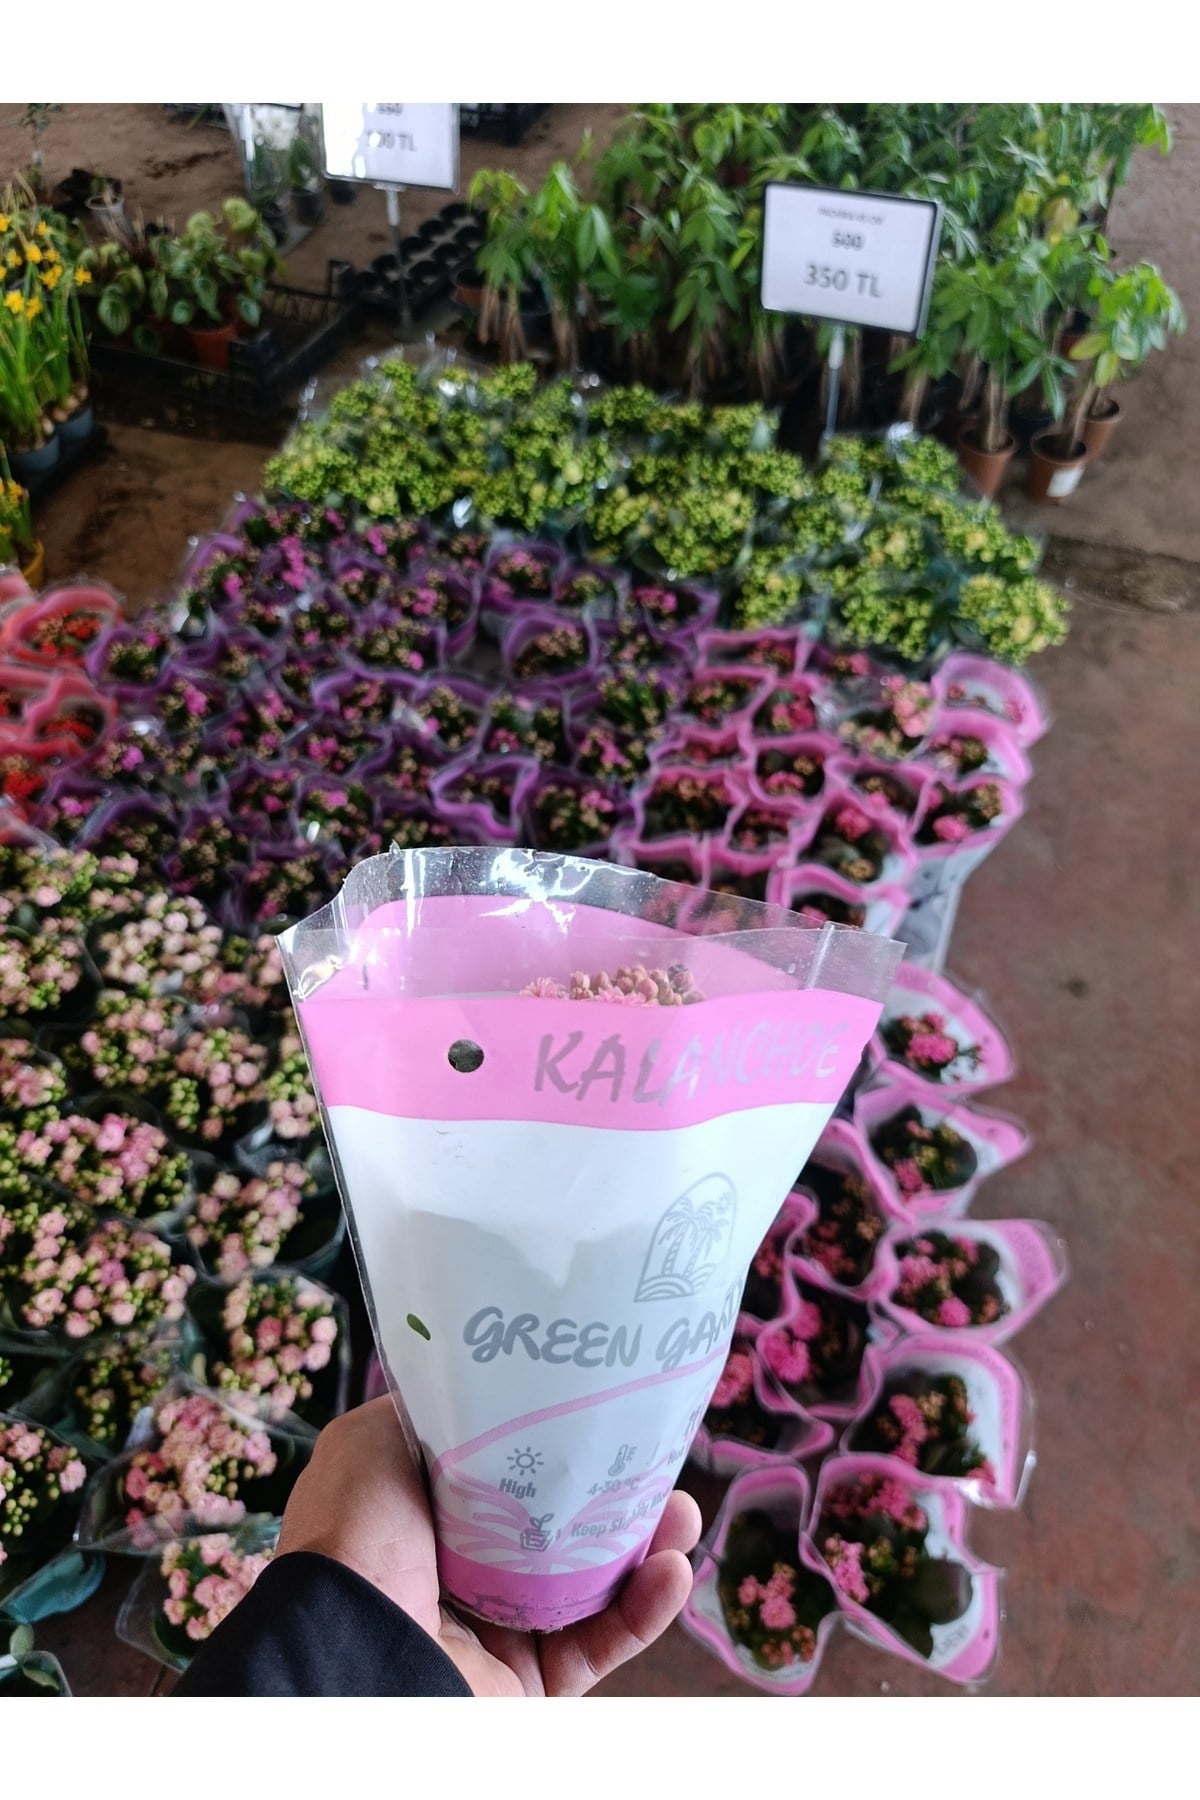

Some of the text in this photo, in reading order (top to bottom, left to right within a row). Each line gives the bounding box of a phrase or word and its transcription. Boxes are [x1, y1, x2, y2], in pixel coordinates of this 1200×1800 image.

[398, 132, 417, 152] TL
[803, 263, 883, 298] 350 TL
[462, 1305, 643, 1368] GREEN
[500, 1477, 537, 1499] High
[571, 1521, 606, 1539] Keep
